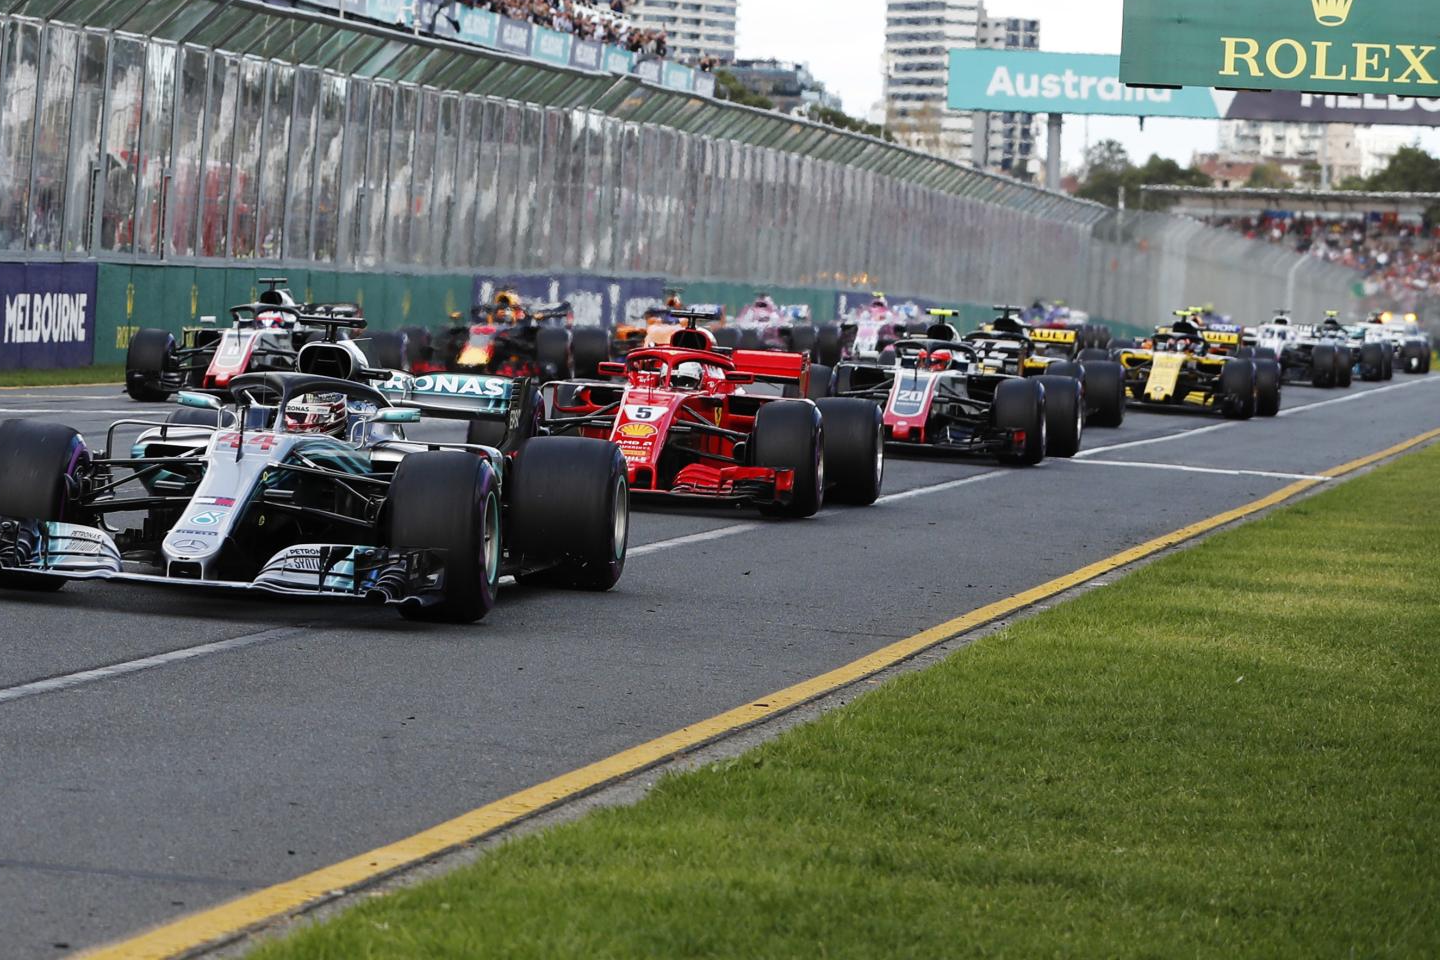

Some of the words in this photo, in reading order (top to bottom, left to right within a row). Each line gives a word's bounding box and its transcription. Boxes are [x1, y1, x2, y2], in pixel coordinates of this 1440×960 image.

[1218, 36, 1439, 86] ROLEX
[4, 292, 88, 344] MELBOURNE
[1029, 330, 1069, 340] AULT
[897, 390, 924, 401] 20
[635, 407, 652, 419] 5
[218, 431, 278, 450] 44
[290, 548, 321, 556] PETRON
